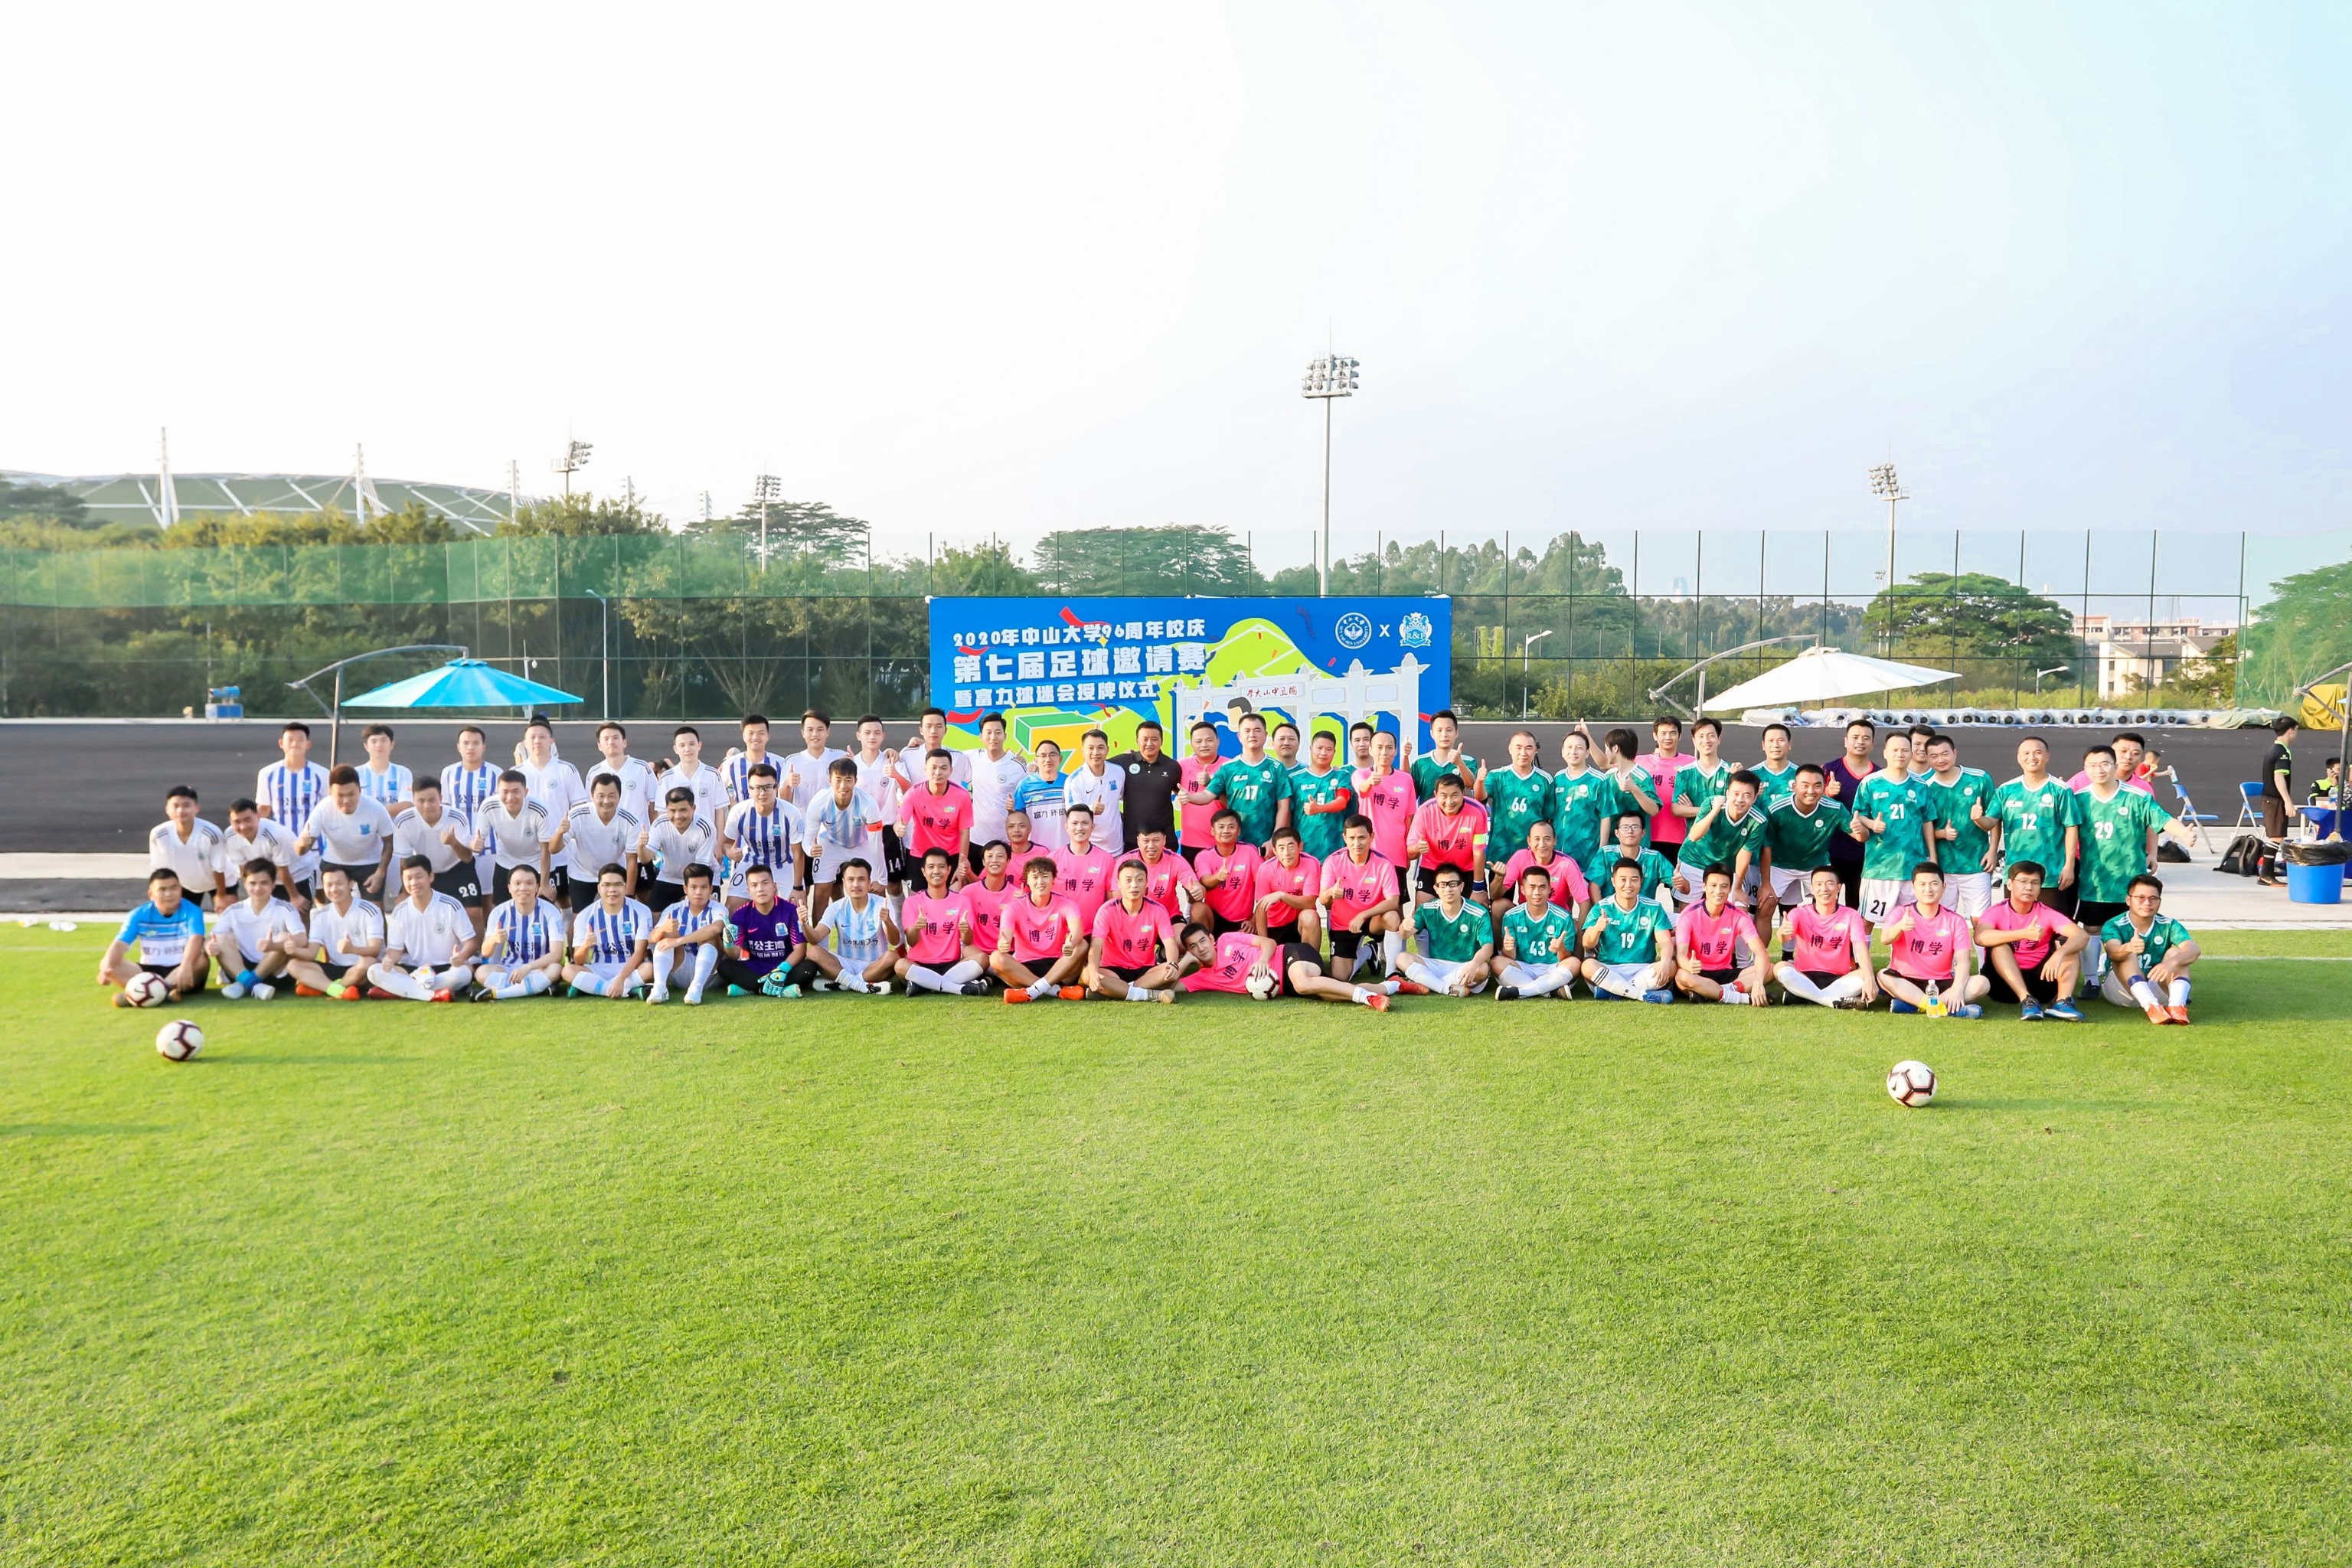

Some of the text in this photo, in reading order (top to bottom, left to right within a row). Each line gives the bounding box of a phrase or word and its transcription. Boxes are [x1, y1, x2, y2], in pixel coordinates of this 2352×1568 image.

[953, 643, 1206, 684] 第七届足球邀请赛
[954, 680, 1160, 707] 暨富力球迷会授牌仪式
[1245, 785, 1258, 800] 17
[1317, 792, 1325, 805] 5
[1374, 793, 1400, 809] 博学
[1511, 797, 1527, 812] 66
[1564, 796, 1573, 812] 2
[1890, 804, 1905, 820] 21
[923, 816, 951, 830] 博学
[2021, 813, 2037, 830] 12
[2094, 822, 2114, 839] 29
[1438, 838, 1467, 850] 博学
[889, 858, 901, 873] 14
[459, 883, 478, 897] 28
[1065, 879, 1094, 892] 博学
[1343, 887, 1370, 902] 博学
[1870, 900, 1886, 916] 21
[925, 922, 954, 935] 博学
[1029, 927, 1056, 942] 博学
[1122, 939, 1150, 952] 博学
[1529, 941, 1547, 956] 43
[1620, 933, 1635, 949] 19
[1700, 940, 1728, 955] 博学
[1810, 934, 1843, 949] 博学
[1911, 939, 1943, 955] 博学
